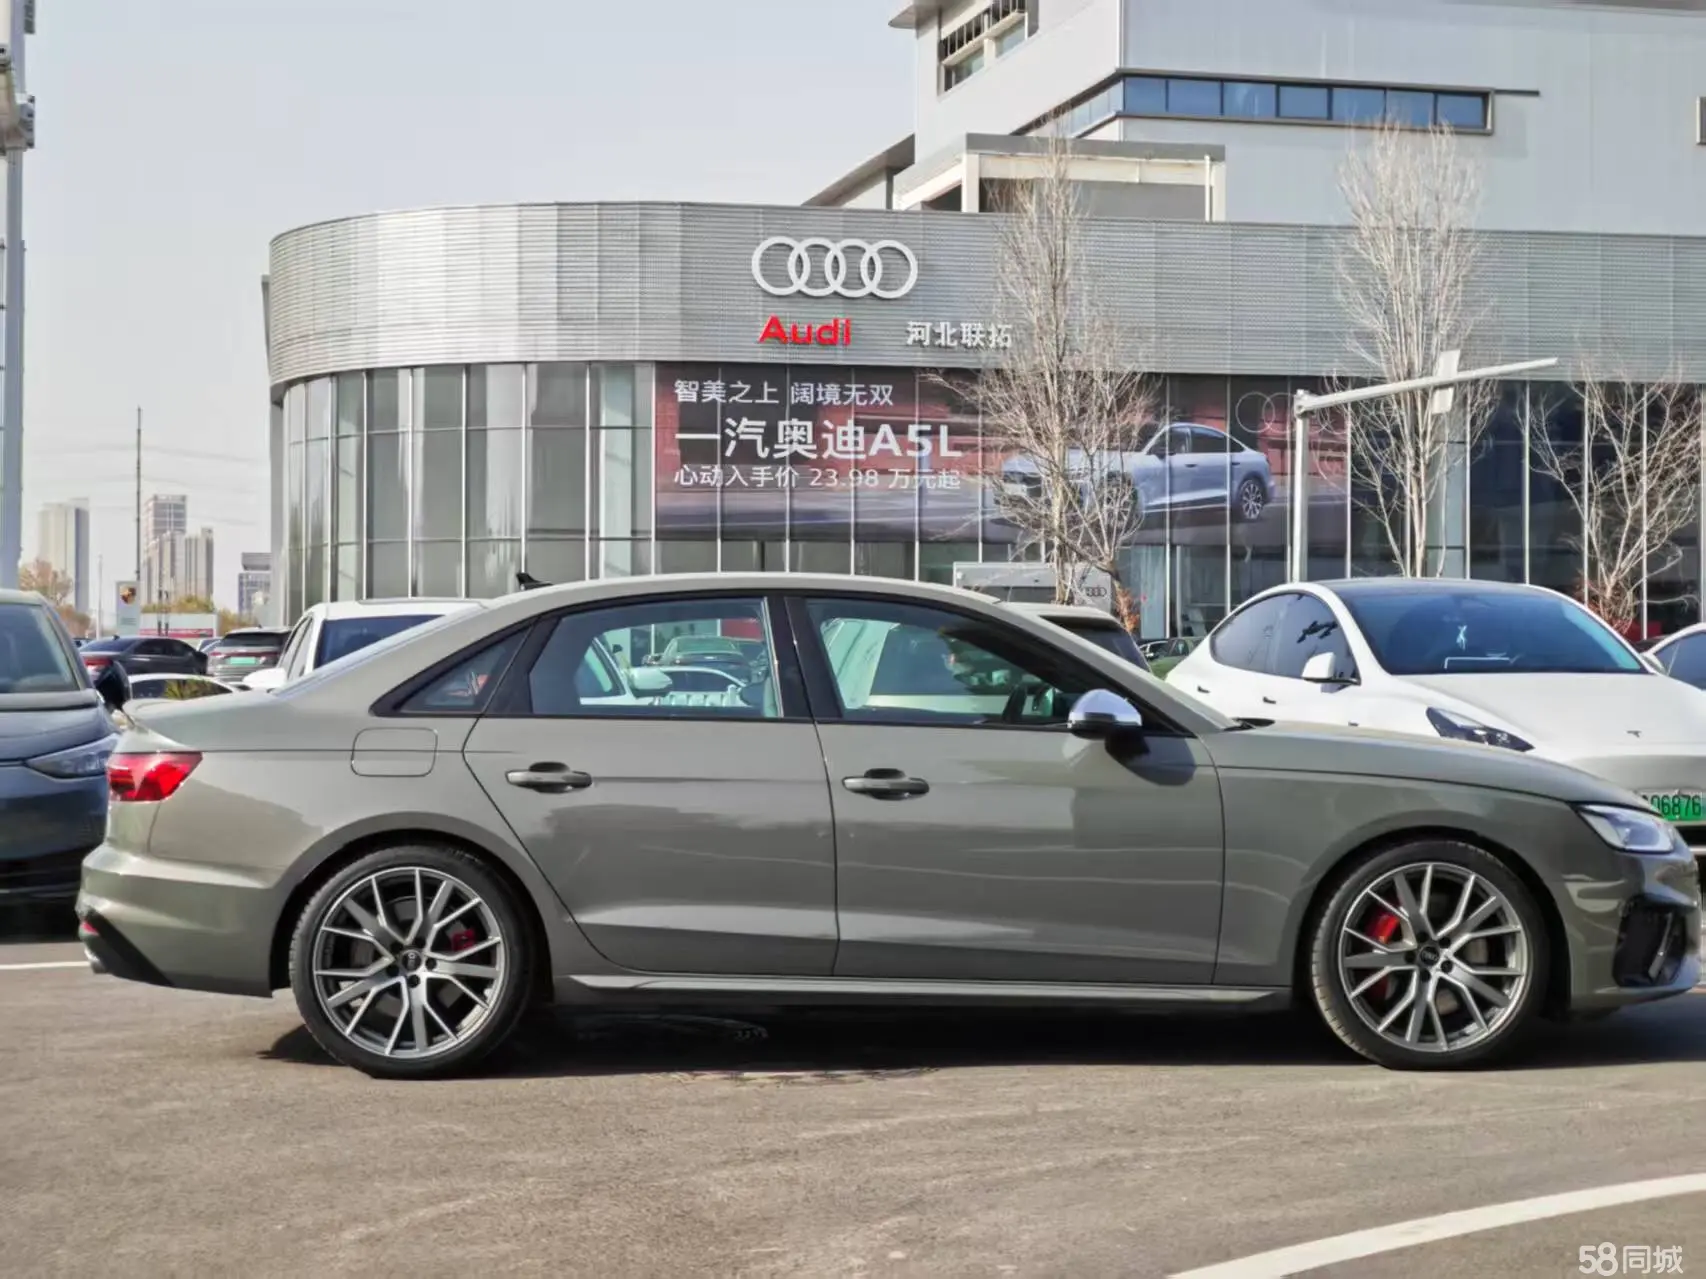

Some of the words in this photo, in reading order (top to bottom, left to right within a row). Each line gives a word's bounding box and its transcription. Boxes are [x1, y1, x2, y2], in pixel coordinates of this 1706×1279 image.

[758, 314, 851, 346] Audi
[906, 320, 1013, 348] 河北联拓
[674, 379, 779, 404] 智美之上
[791, 381, 894, 406] 阔境无双
[675, 416, 963, 460] 一汽奥迪A5L
[674, 465, 799, 488] 心动入手价
[809, 468, 879, 488] 23.98
[888, 468, 961, 490] 万元起
[1641, 794, 1701, 817] 06876
